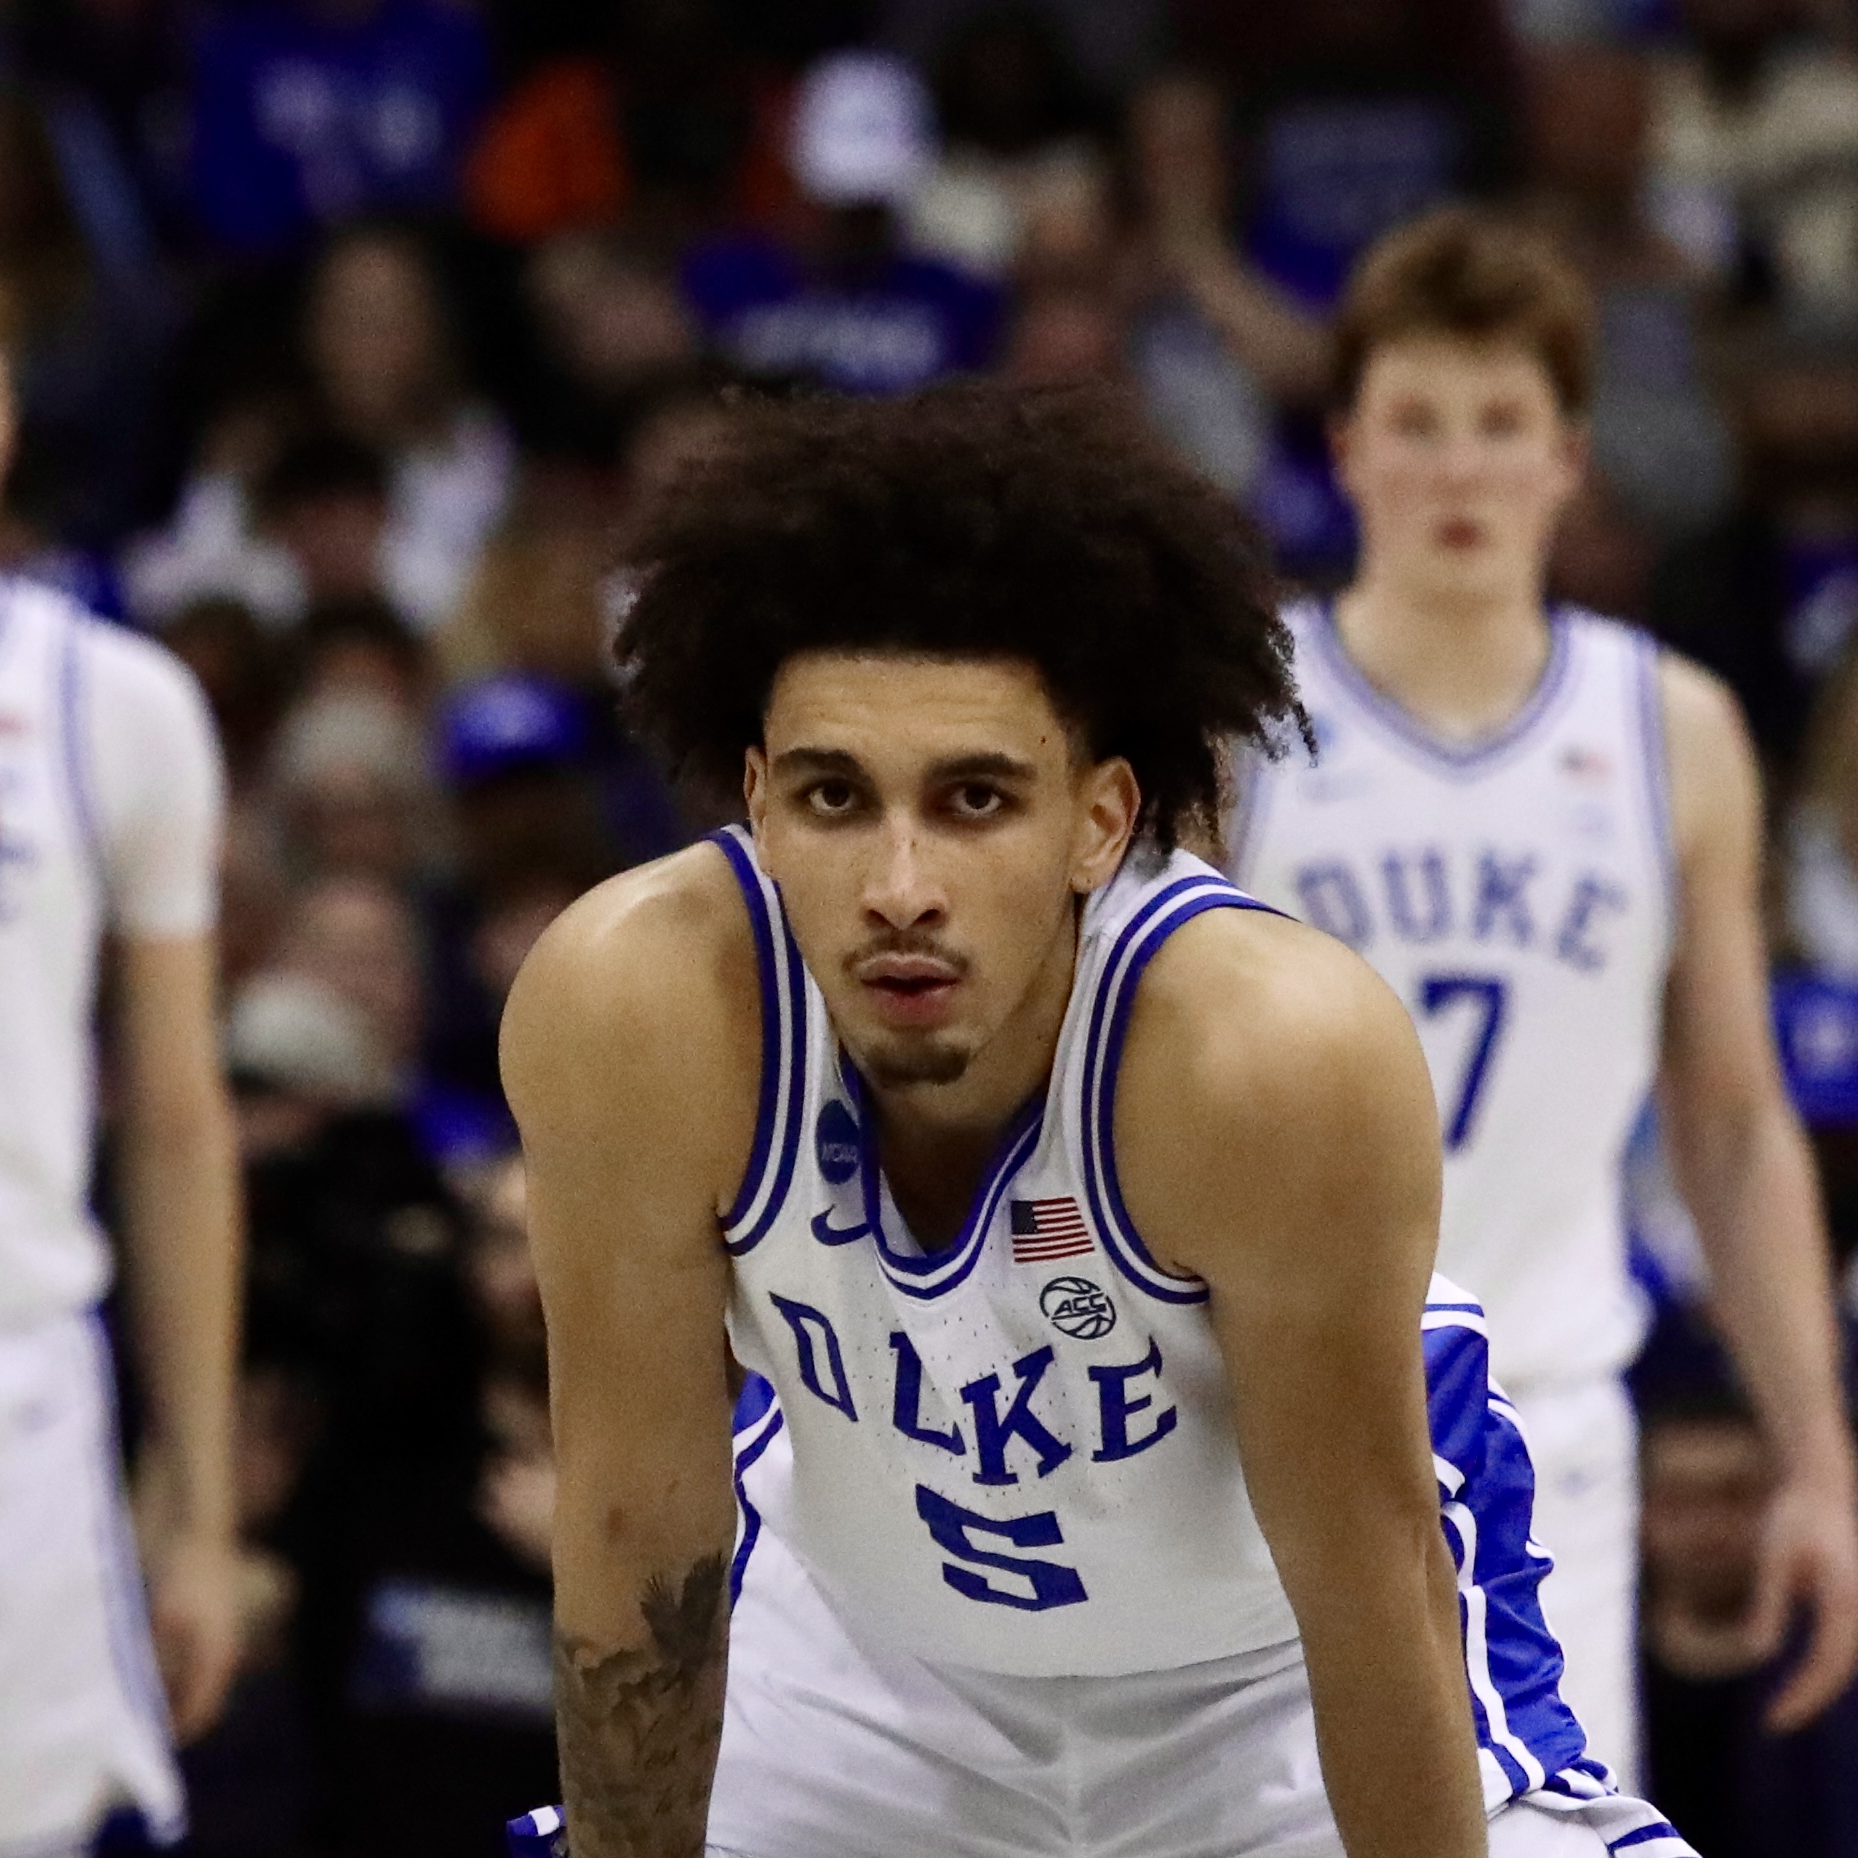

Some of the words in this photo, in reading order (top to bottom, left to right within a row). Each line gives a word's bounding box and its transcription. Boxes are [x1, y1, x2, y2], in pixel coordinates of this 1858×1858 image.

[1297, 848, 1628, 972] DUKE
[1421, 977, 1505, 1151] 7
[915, 1484, 1089, 1611] 5
